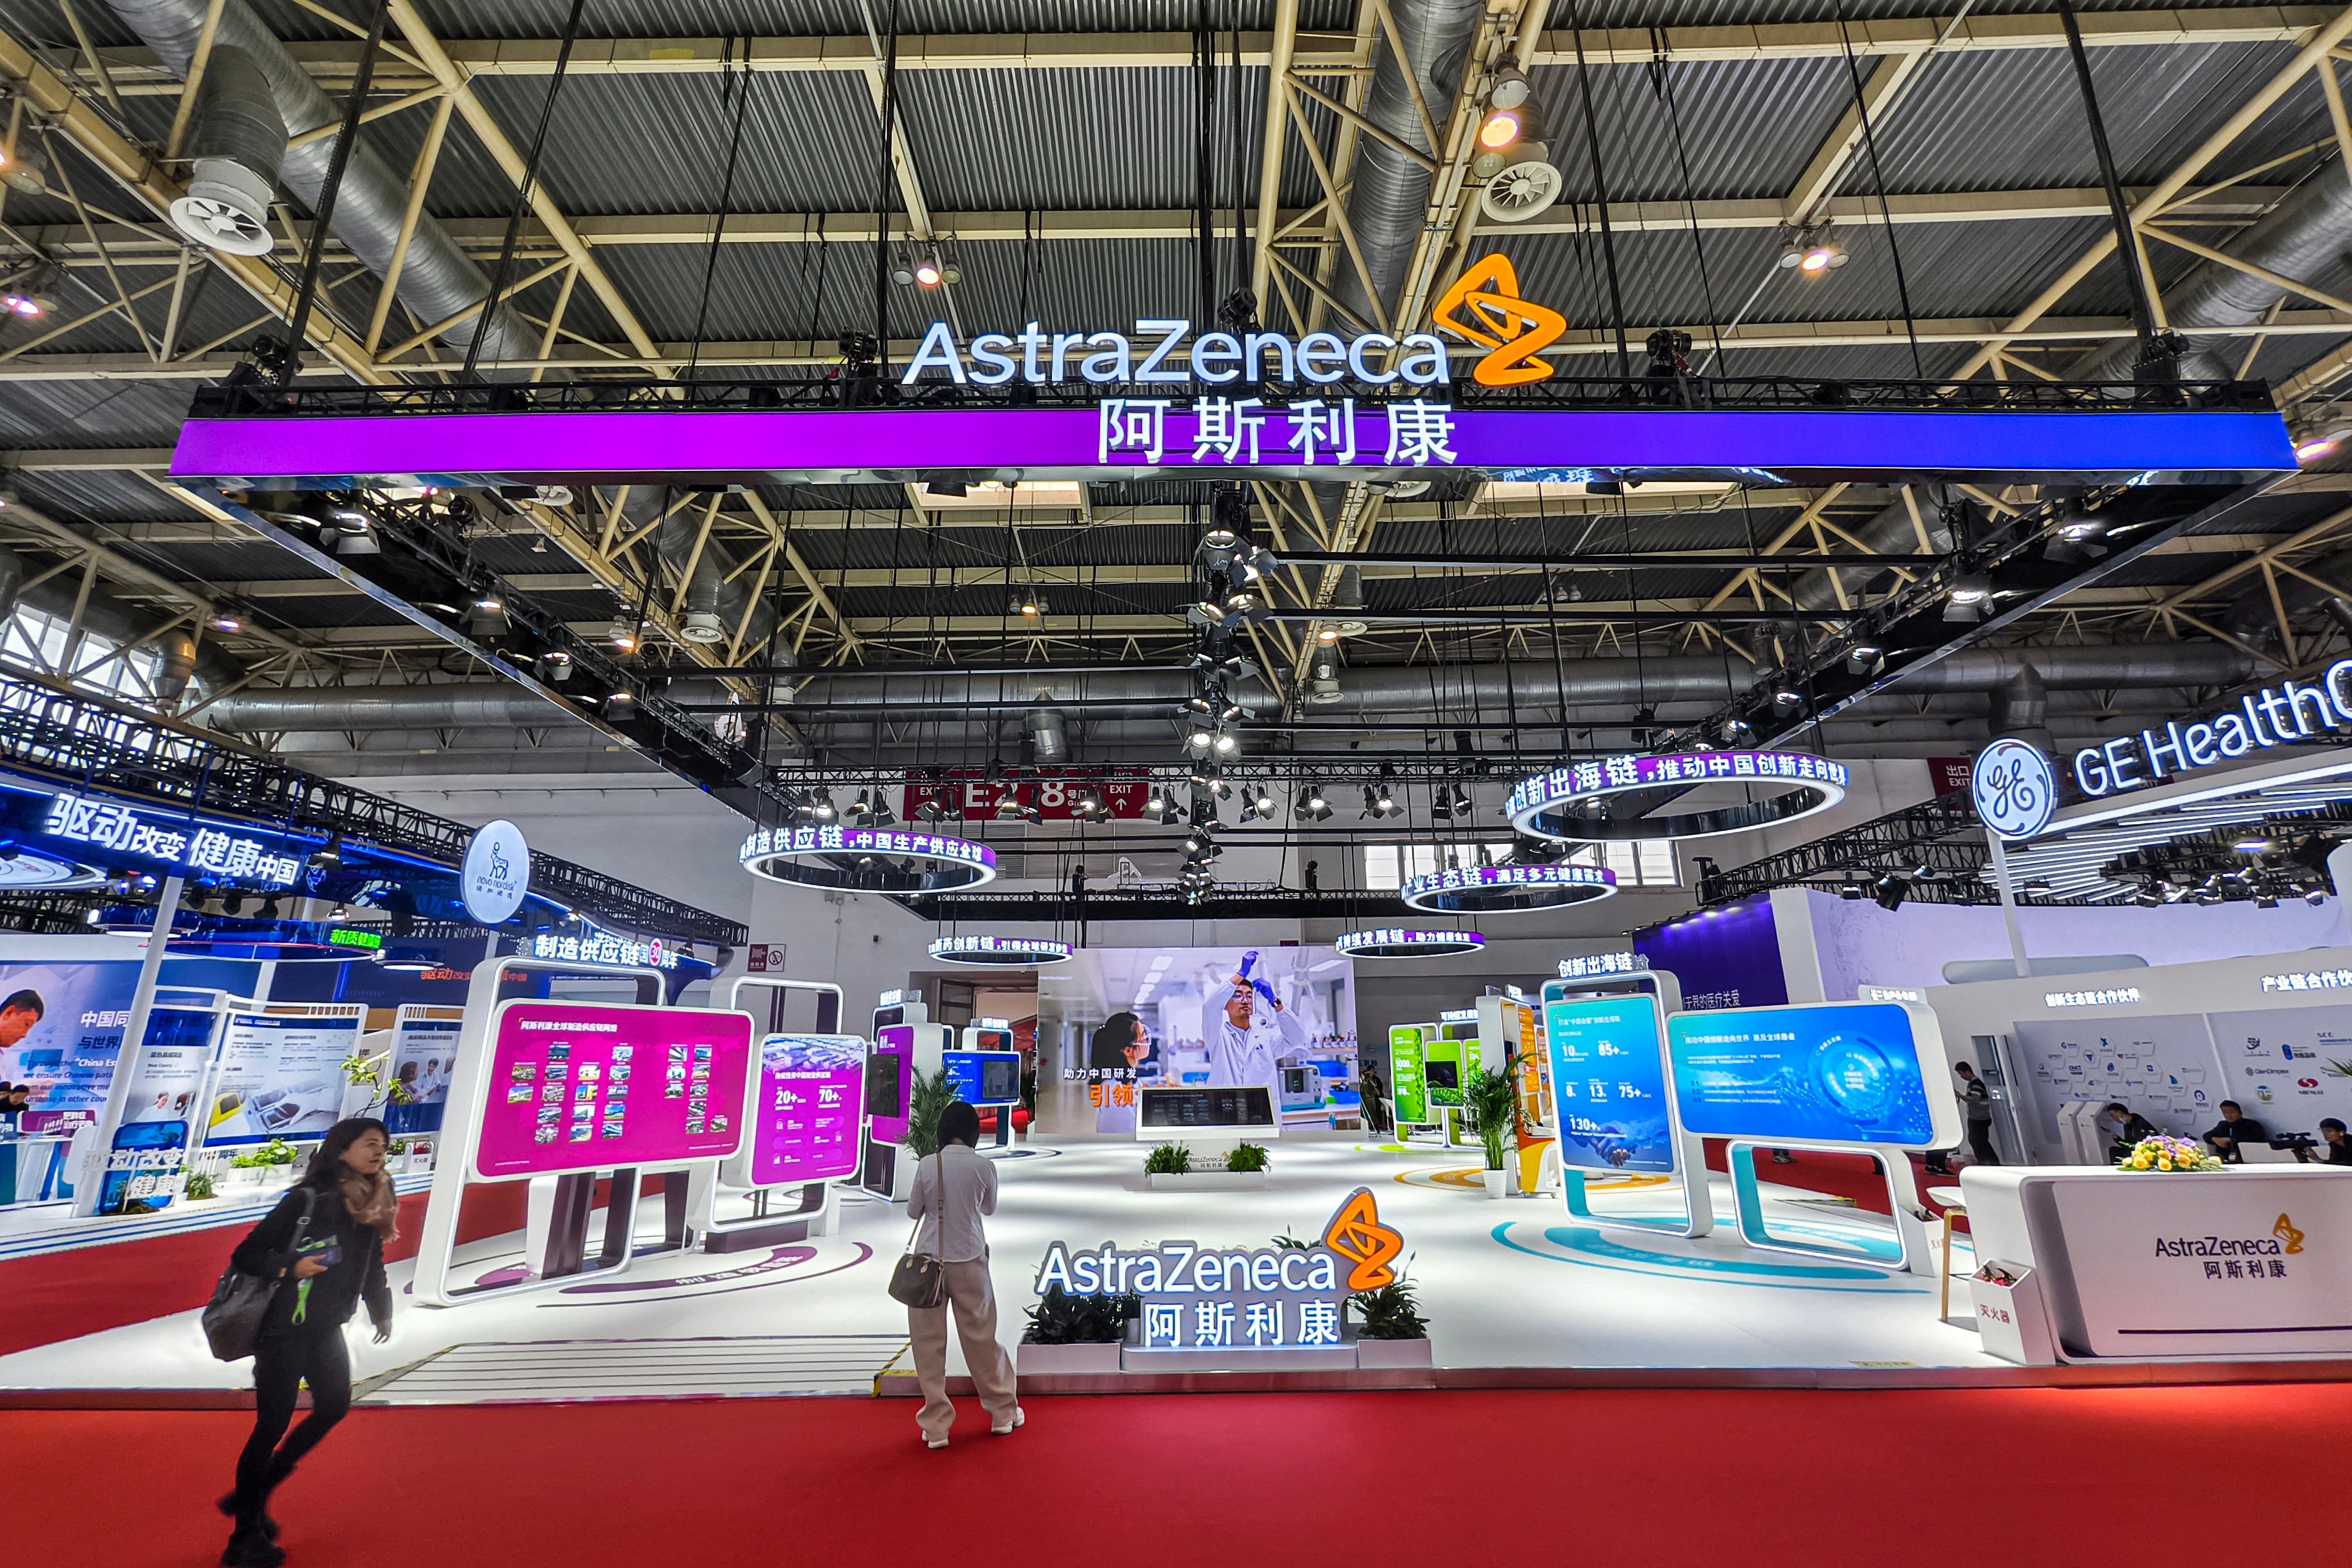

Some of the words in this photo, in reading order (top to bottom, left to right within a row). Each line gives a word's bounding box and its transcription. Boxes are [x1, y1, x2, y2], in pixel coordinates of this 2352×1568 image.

[901, 318, 1451, 387] AstraZeneca
[1099, 397, 1457, 465] 阿斯利康
[1946, 764, 1969, 777] 出口
[2075, 736, 2142, 795] GE
[920, 787, 942, 795] EXI
[1110, 785, 1132, 794] EXIT
[1949, 778, 1971, 787] EXIT
[46, 793, 187, 862] 驱动改变
[189, 827, 300, 885] 健康中国
[477, 876, 492, 886] novo
[535, 934, 640, 966] 制造供应链
[1558, 952, 1633, 978] 创新出海链
[2045, 988, 2141, 1007] 创新生态链合作伙伴
[1562, 1045, 1575, 1057] 10
[1063, 1068, 1137, 1079] 助力中国研发
[775, 1090, 798, 1104] 20+
[819, 1088, 839, 1103] 70+
[1589, 1085, 1604, 1097] 13
[1619, 1085, 1641, 1099] 75+
[1570, 1118, 1597, 1131] 130+
[2155, 1236, 2281, 1257] AstraZeneca
[1037, 1246, 1336, 1296] AstraZeneca
[2204, 1260, 2287, 1279] 阿斯利康
[1980, 1304, 2010, 1324] 灭火器
[1144, 1299, 1339, 1347] 阿斯利康
